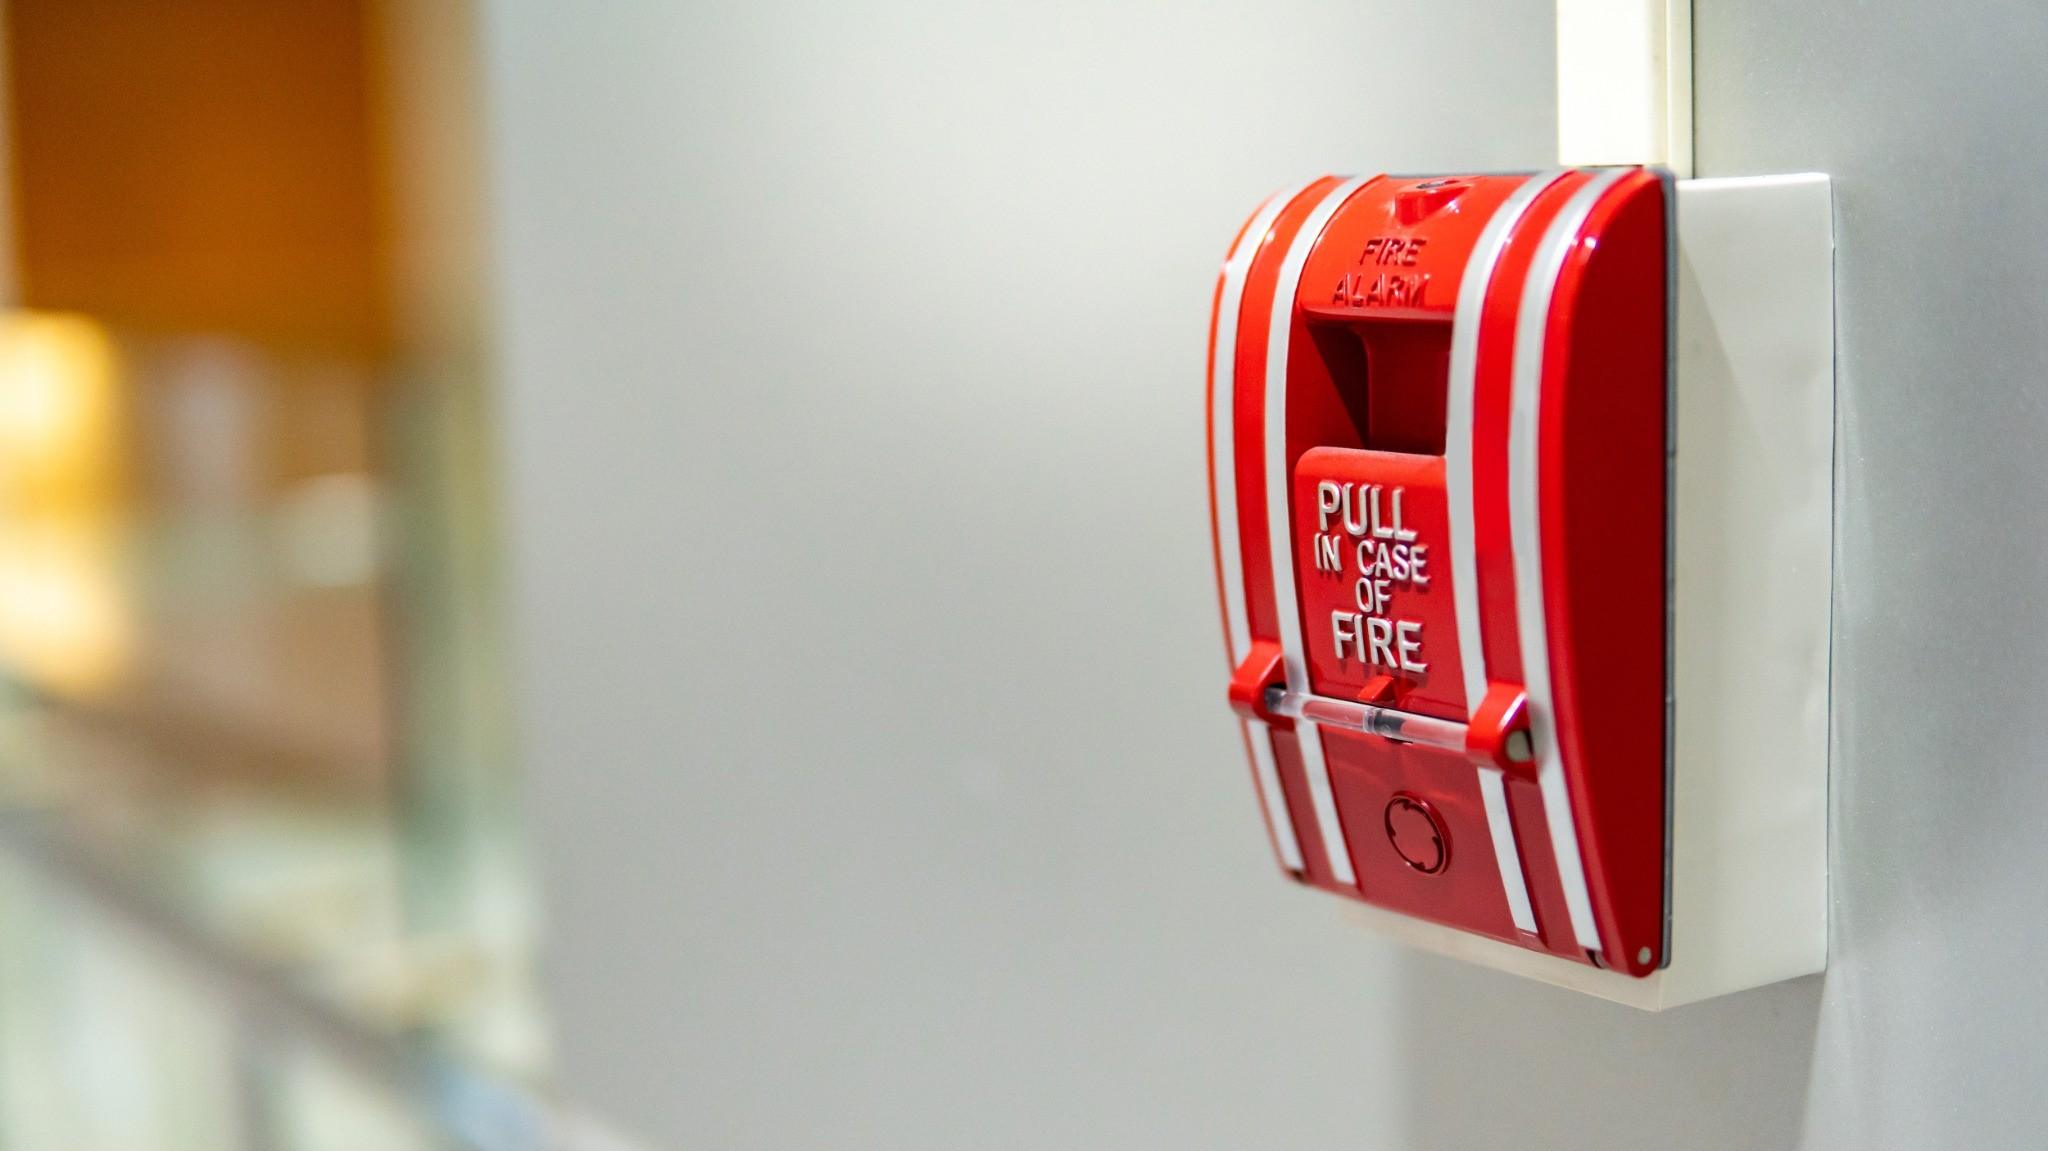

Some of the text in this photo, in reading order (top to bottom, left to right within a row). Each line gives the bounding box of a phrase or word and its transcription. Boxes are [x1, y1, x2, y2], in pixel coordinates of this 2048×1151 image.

[1359, 238, 1427, 267] FIRE
[1332, 273, 1430, 308] ALARM
[1318, 480, 1418, 541] PULL
[1314, 532, 1431, 584] IN CASE
[1355, 577, 1393, 615] OF
[1331, 609, 1429, 673] FIRE
